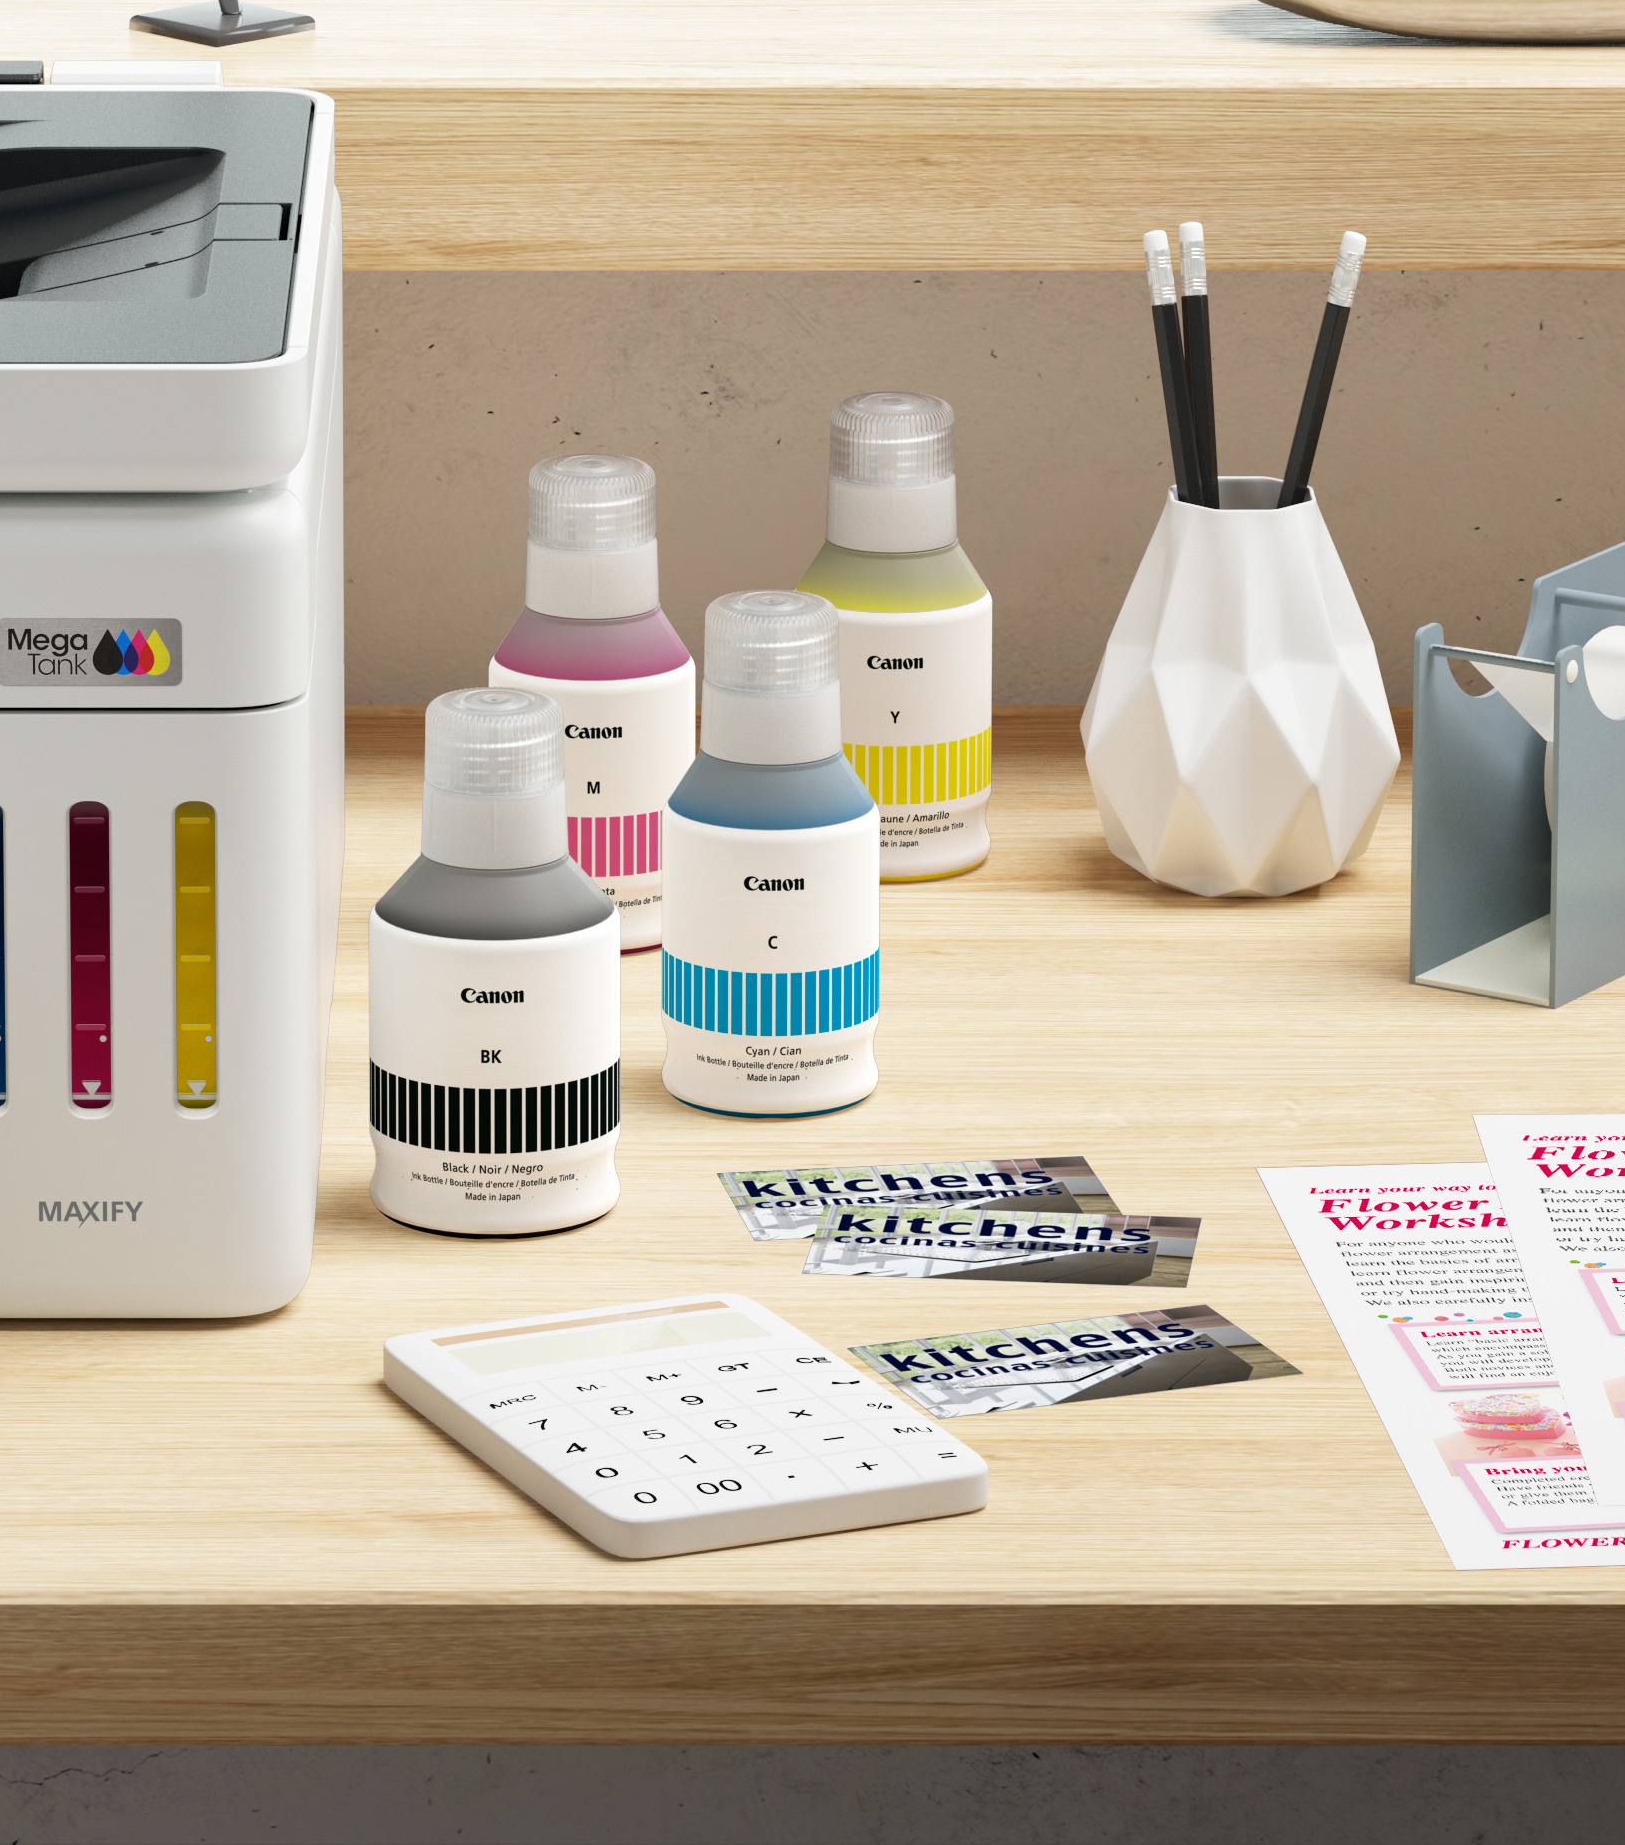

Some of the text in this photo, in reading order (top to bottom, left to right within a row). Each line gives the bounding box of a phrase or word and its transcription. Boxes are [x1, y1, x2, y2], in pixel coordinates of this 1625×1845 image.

[7, 627, 88, 656] Mega
[27, 653, 88, 676] Tank
[866, 655, 924, 670] Canon
[890, 710, 901, 724] Y
[564, 724, 623, 740] Canon
[587, 781, 601, 795] M
[743, 875, 805, 892] Canon
[767, 935, 778, 950] C
[460, 987, 525, 1004] Canon
[480, 1049, 502, 1064] BK
[745, 1046, 771, 1058] Cyan
[779, 1046, 802, 1056] Cian
[746, 1073, 768, 1082] Made
[778, 1073, 801, 1084] Japan
[442, 1162, 470, 1174] Black
[479, 1165, 502, 1175] Noir
[511, 1163, 544, 1176] Negro
[423, 1174, 444, 1185] Bottle
[449, 1178, 484, 1189] Bouteille
[520, 1177, 547, 1188] Botella
[559, 1172, 576, 1183] Tinta
[742, 1168, 1055, 1199] kitchens
[464, 1192, 522, 1203] Made in Japan
[754, 1183, 1064, 1210] cocinas cuisines
[38, 1200, 144, 1229] MAXIFY
[1317, 1198, 1490, 1214] Flower
[837, 1213, 1152, 1243] kitchens
[1324, 1212, 1508, 1231] Worksh
[833, 1235, 1150, 1255] cocinas cuisines
[879, 1322, 1196, 1373] kitchens
[717, 1362, 751, 1374] GT
[910, 1336, 1215, 1385] cocinas cuisines
[488, 1394, 538, 1410] MRC
[527, 1395, 705, 1431] 7 8 9
[565, 1419, 739, 1455] 4 5 6
[679, 1454, 699, 1466] 1
[747, 1443, 774, 1456] 2
[633, 1478, 743, 1504] 0 00
